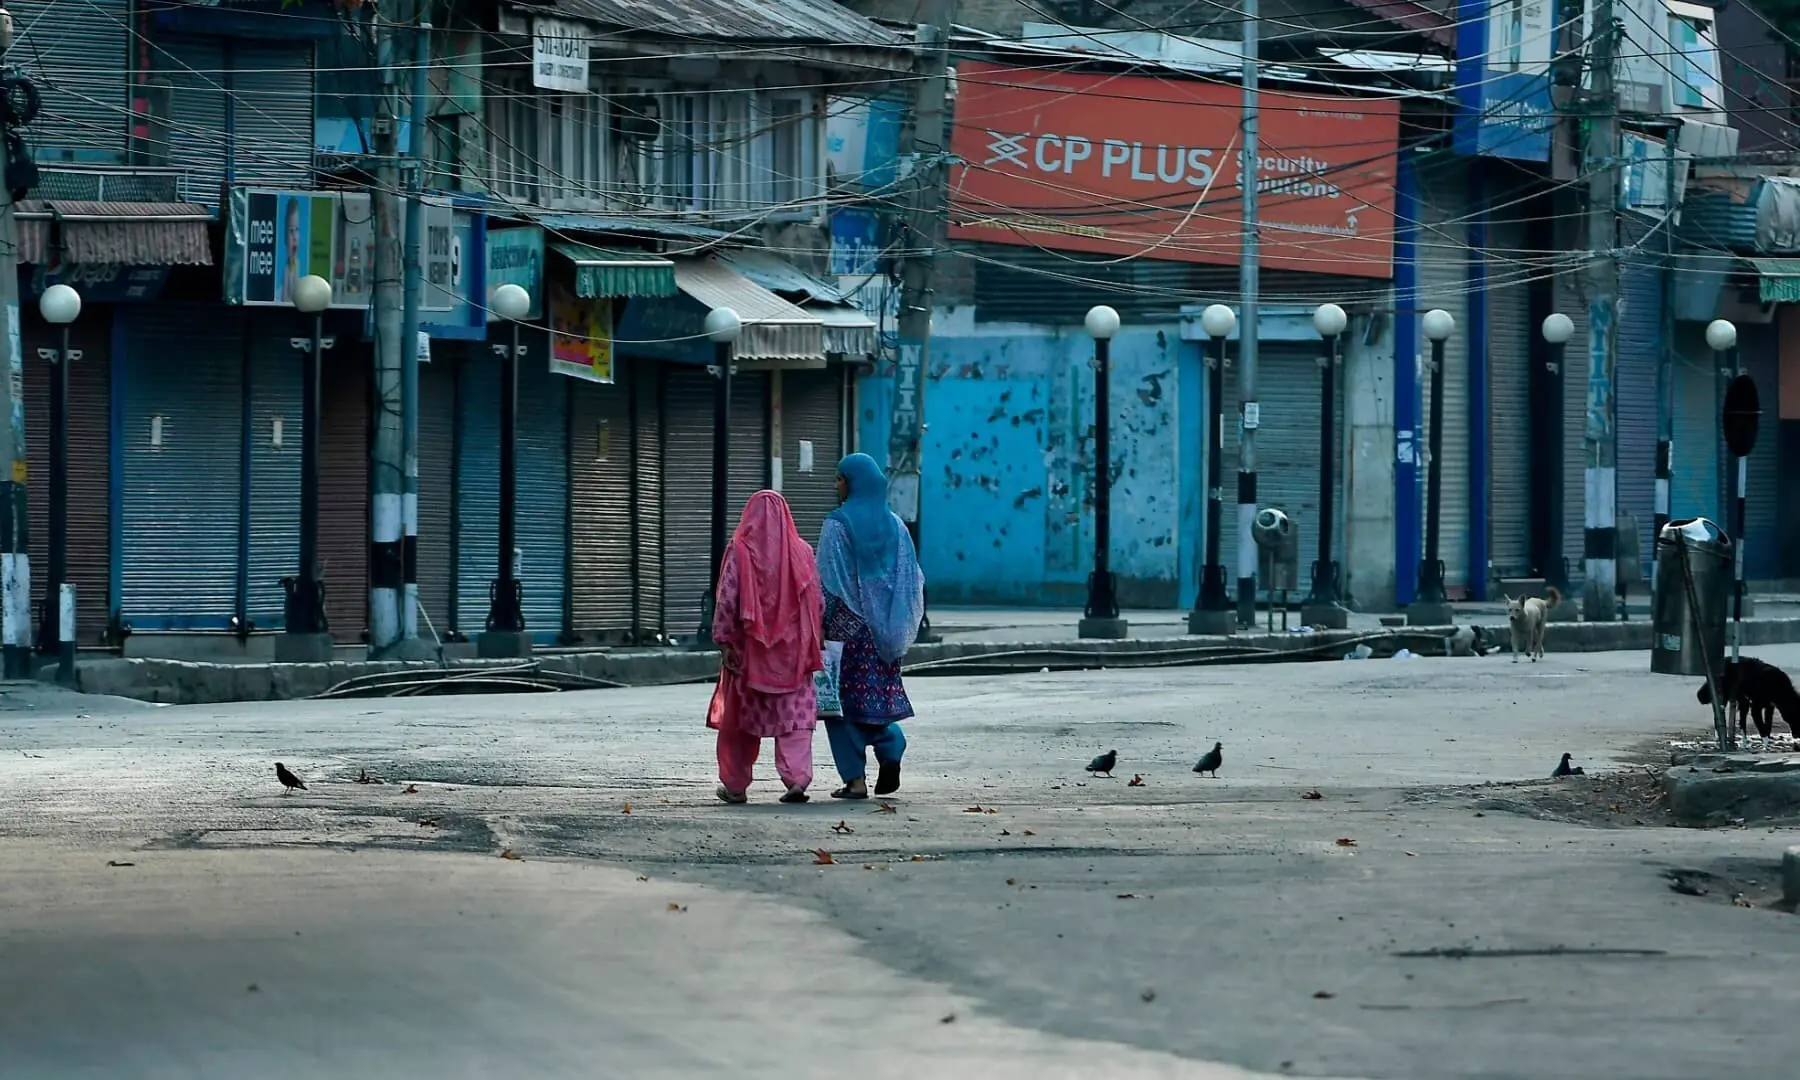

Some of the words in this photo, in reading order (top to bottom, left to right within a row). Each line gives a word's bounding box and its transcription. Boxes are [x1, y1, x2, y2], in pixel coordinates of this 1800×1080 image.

[1035, 133, 1092, 174] CP
[1102, 138, 1214, 187] PLUS
[250, 219, 274, 245] mee
[249, 250, 273, 276] mee
